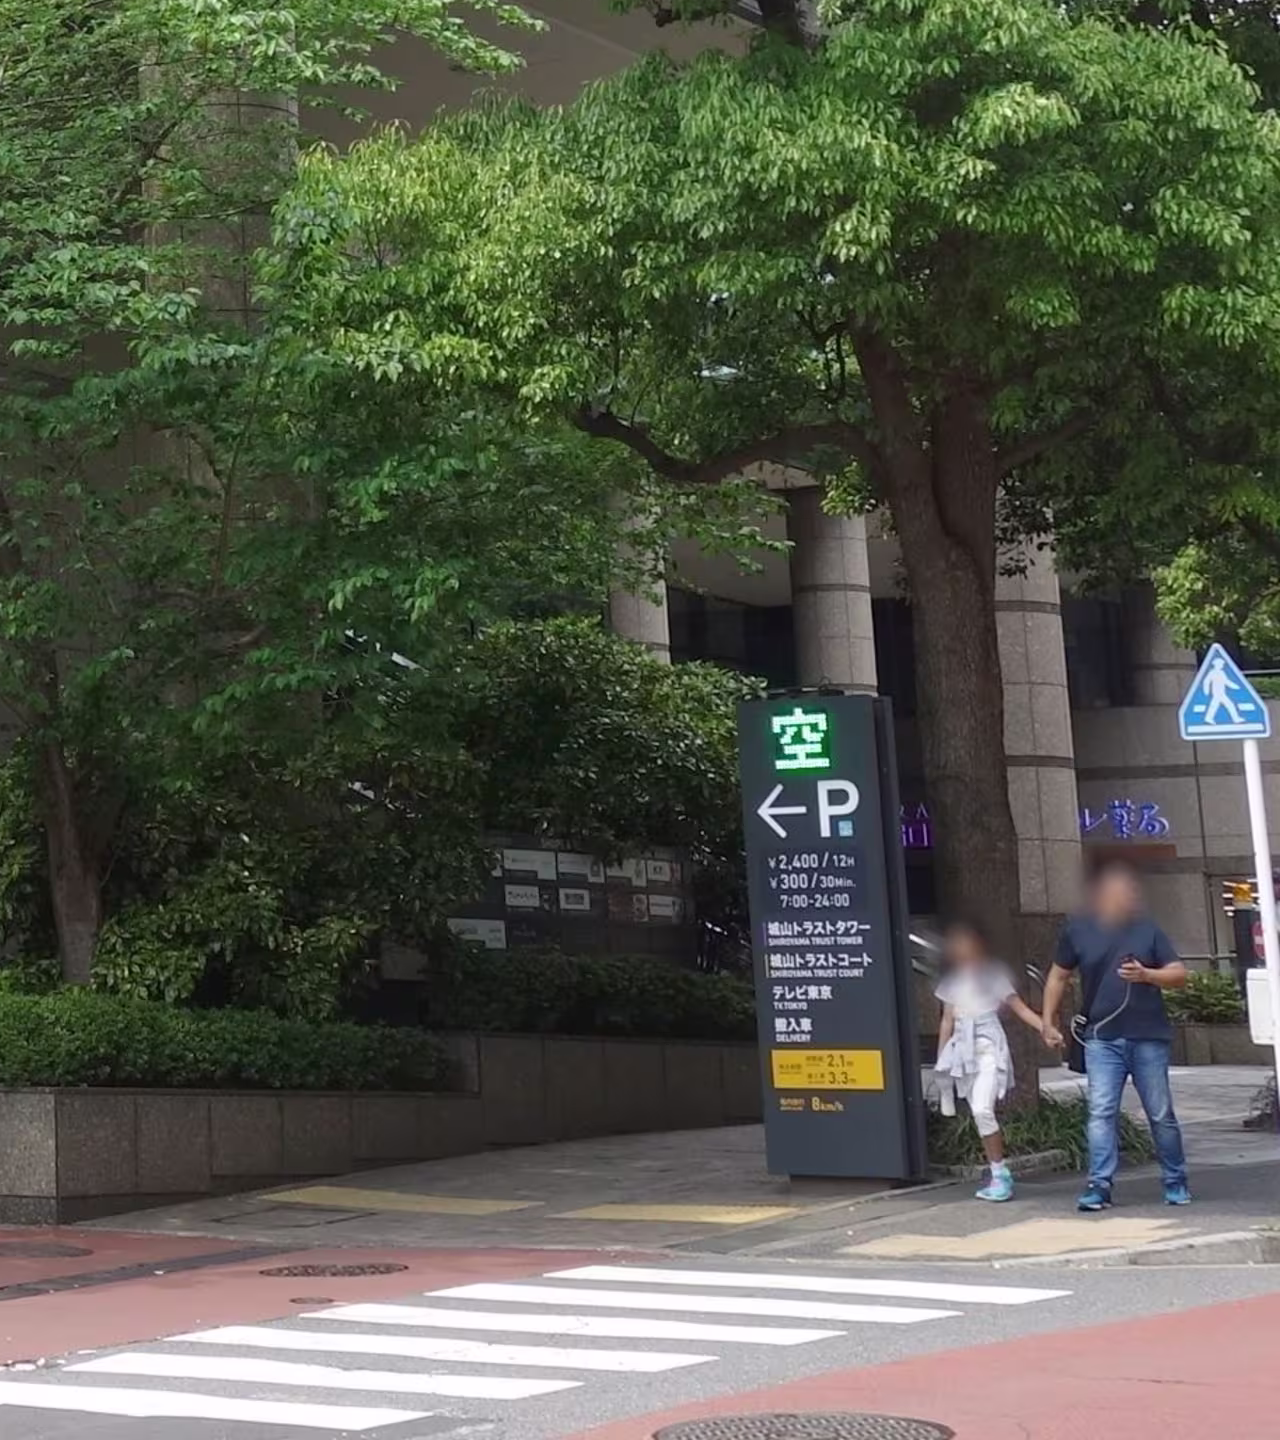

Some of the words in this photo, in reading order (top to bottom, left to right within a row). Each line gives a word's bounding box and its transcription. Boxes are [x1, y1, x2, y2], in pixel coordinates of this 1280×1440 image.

[772, 707, 830, 769] 空
[817, 779, 859, 837] P
[780, 894, 850, 908] 7:00-24:00
[768, 921, 871, 936] 城山トラストタワー
[769, 937, 810, 946] SHIROYAMA
[811, 937, 835, 945] TRUST
[836, 936, 863, 945] TOWER
[770, 953, 873, 968] 城山トラストコート
[770, 969, 813, 978] SHIROYAMA
[813, 969, 837, 977] TRUST
[838, 969, 864, 977] COURT
[772, 985, 833, 1000] テレビ東京
[775, 1034, 811, 1042] DELIVERY
